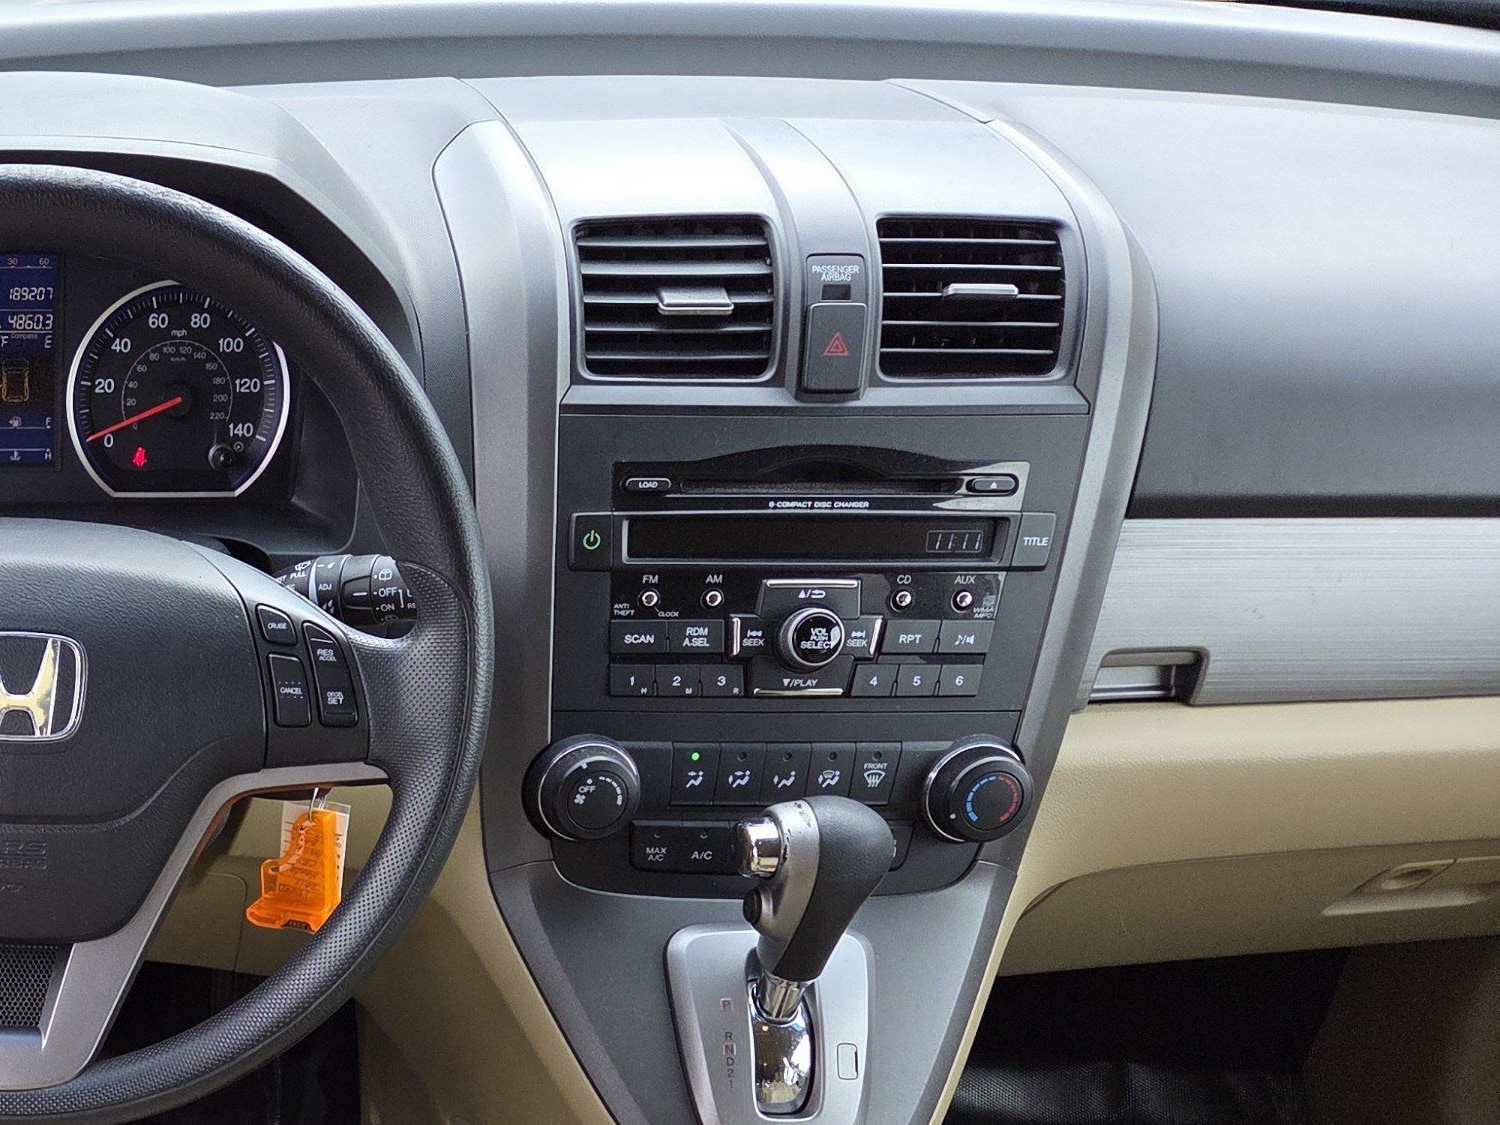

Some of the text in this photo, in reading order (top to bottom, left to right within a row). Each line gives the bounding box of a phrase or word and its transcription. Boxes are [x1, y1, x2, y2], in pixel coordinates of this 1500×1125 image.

[7, 258, 18, 266] 30
[39, 258, 50, 266] 60
[811, 265, 860, 274] PASSENGER
[821, 273, 852, 282] AIRBAG
[9, 287, 54, 301] 189207
[8, 313, 54, 330] 4860.3
[148, 313, 170, 329] 60
[190, 313, 211, 329] 80
[170, 328, 188, 338] mph
[111, 337, 132, 353] 40
[218, 337, 245, 353] 100
[94, 378, 116, 394] 20
[234, 377, 261, 393] 120
[228, 422, 254, 438] 140
[103, 433, 114, 448] 0
[638, 481, 659, 489] LOAD
[813, 500, 833, 508] DISC
[833, 500, 870, 508] CHANGER
[1023, 537, 1050, 547] TITLE
[642, 574, 659, 585] FM
[705, 574, 723, 585] AM
[896, 574, 912, 585] CD
[954, 575, 976, 585] AUX
[318, 583, 333, 591] ADJ
[378, 587, 398, 598] OFF
[380, 603, 395, 612] ON
[613, 609, 635, 617] THEFT
[267, 622, 288, 630] CRUISE
[686, 626, 709, 636] RDM
[810, 627, 829, 637] VOL
[624, 634, 655, 645] SCAN
[742, 639, 765, 647] SEEK
[846, 639, 868, 647] SEEK
[898, 634, 922, 644] RPT
[317, 648, 334, 657] RES
[629, 675, 636, 687] 1
[672, 675, 682, 687] 2
[717, 675, 727, 687] 3
[869, 675, 878, 687] 4
[912, 675, 922, 686] 5
[955, 675, 965, 686] 6
[280, 686, 303, 694] CANCEL
[863, 762, 889, 770] FRONT
[578, 786, 596, 794] OFF
[646, 847, 668, 855] MAX
[691, 851, 713, 860] A/C
[647, 854, 665, 862] A/C
[724, 1031, 733, 1041] R
[726, 1056, 735, 1067] D
[726, 1068, 735, 1078] 2
